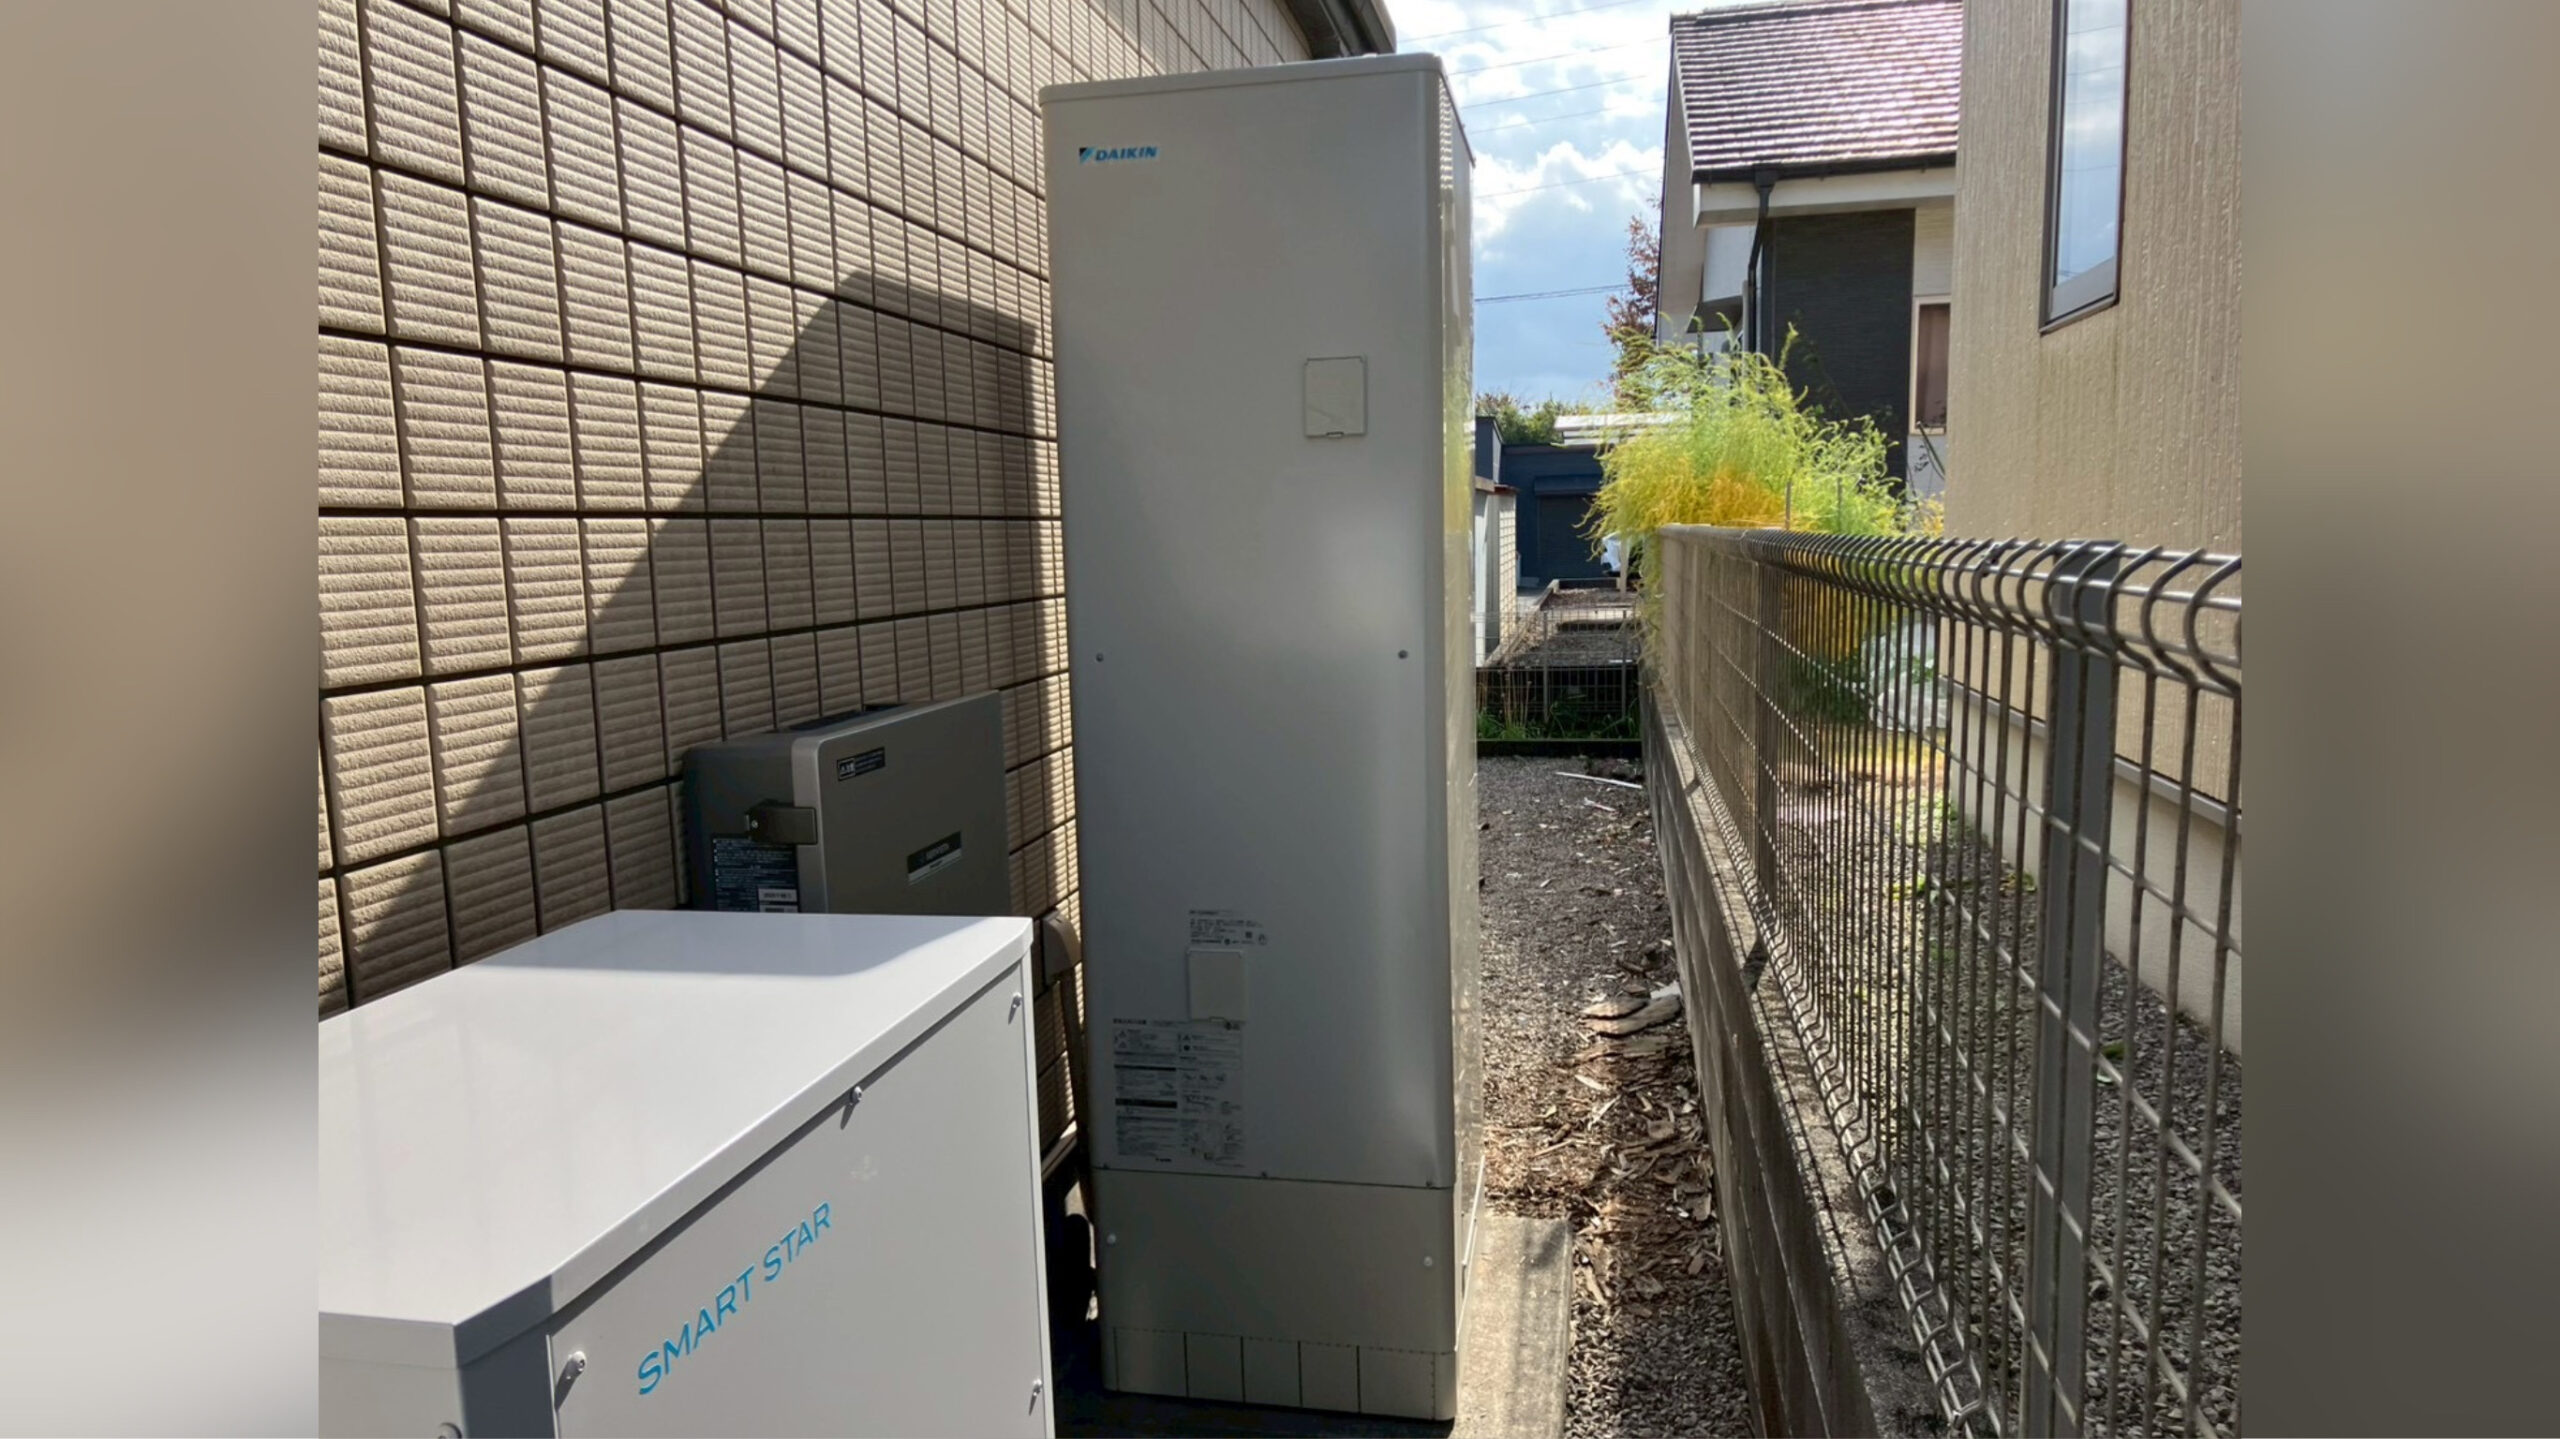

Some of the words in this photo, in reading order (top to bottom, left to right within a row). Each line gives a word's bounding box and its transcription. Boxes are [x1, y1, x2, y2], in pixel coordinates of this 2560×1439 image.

[1095, 146, 1158, 161] DAIKIN
[637, 1263, 756, 1396] SMART
[762, 1201, 832, 1282] STAR
